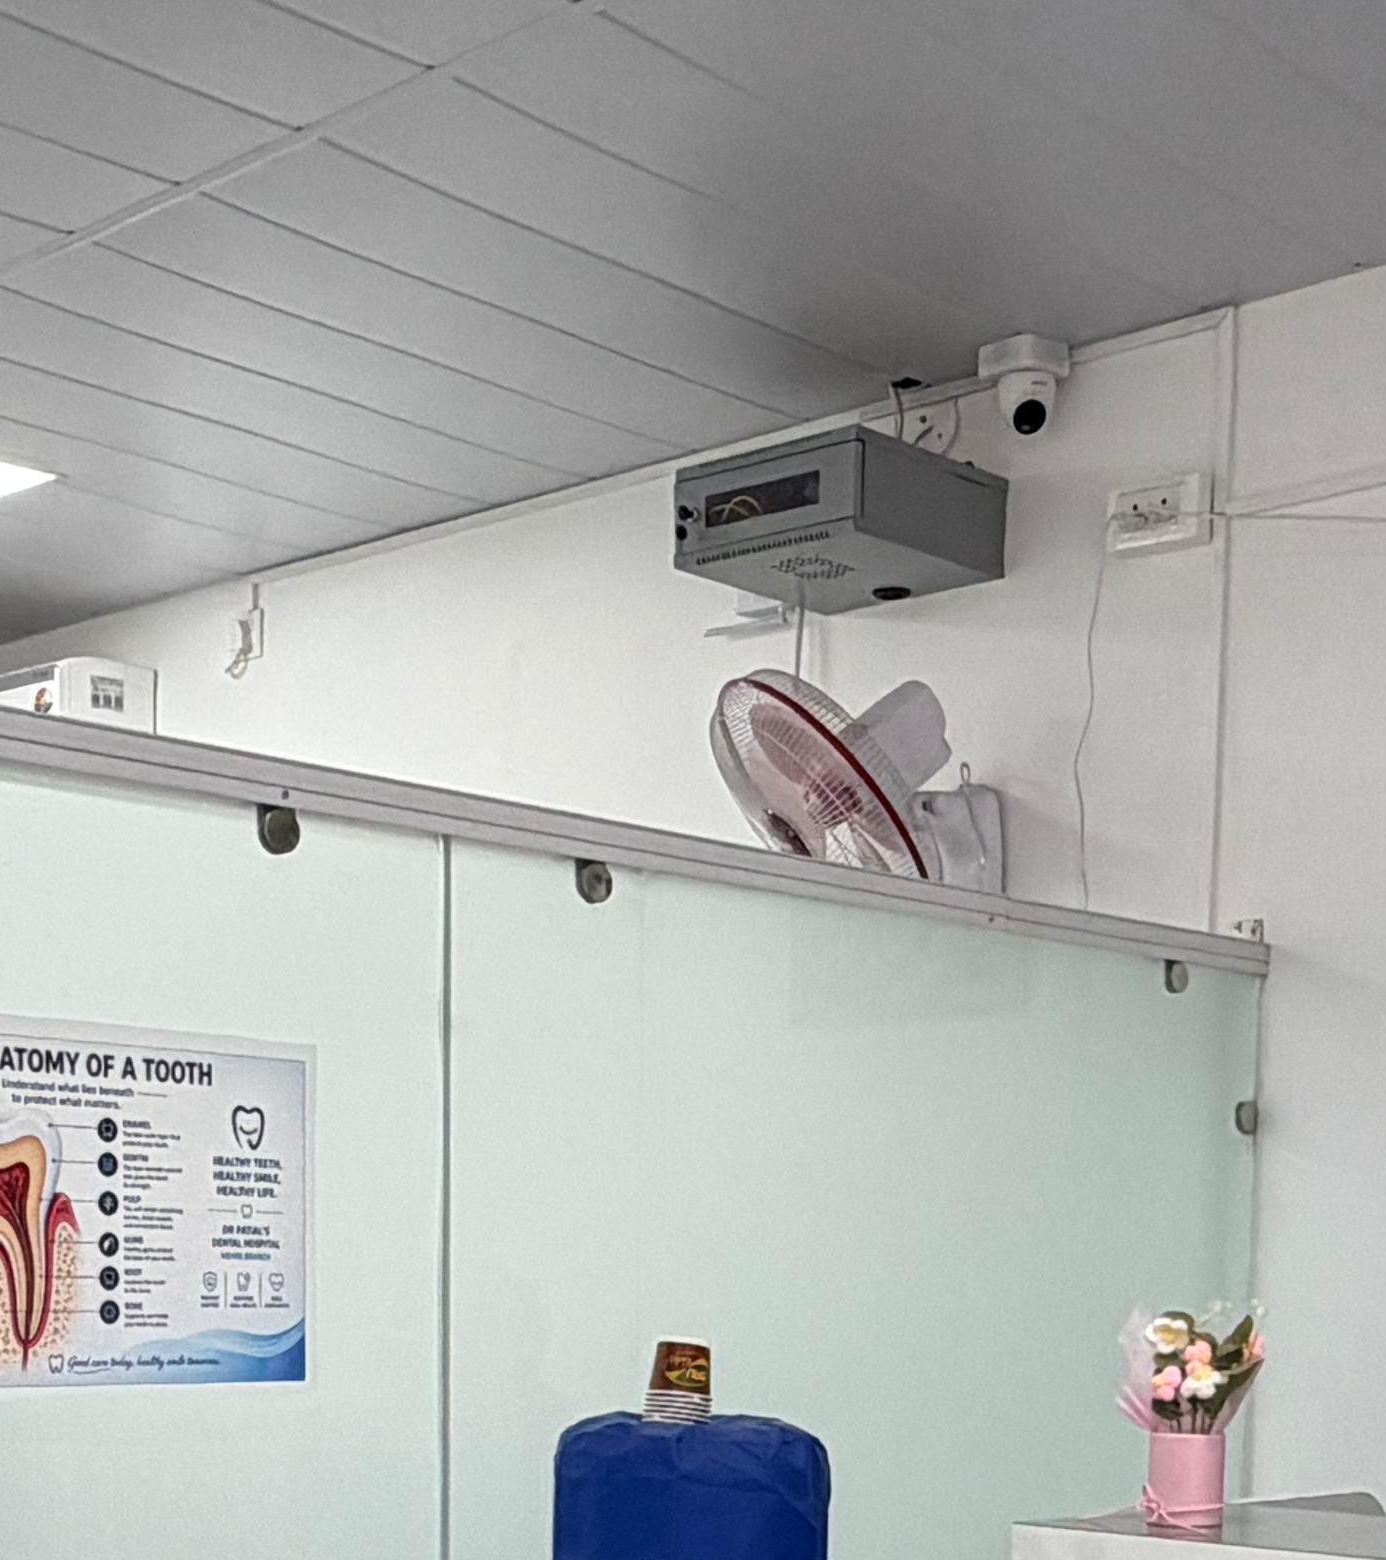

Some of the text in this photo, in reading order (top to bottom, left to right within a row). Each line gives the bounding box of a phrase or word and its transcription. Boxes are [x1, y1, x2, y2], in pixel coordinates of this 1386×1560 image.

[86, 1053, 115, 1078] OF
[121, 1057, 137, 1080] A
[143, 1059, 212, 1086] TOOTH
